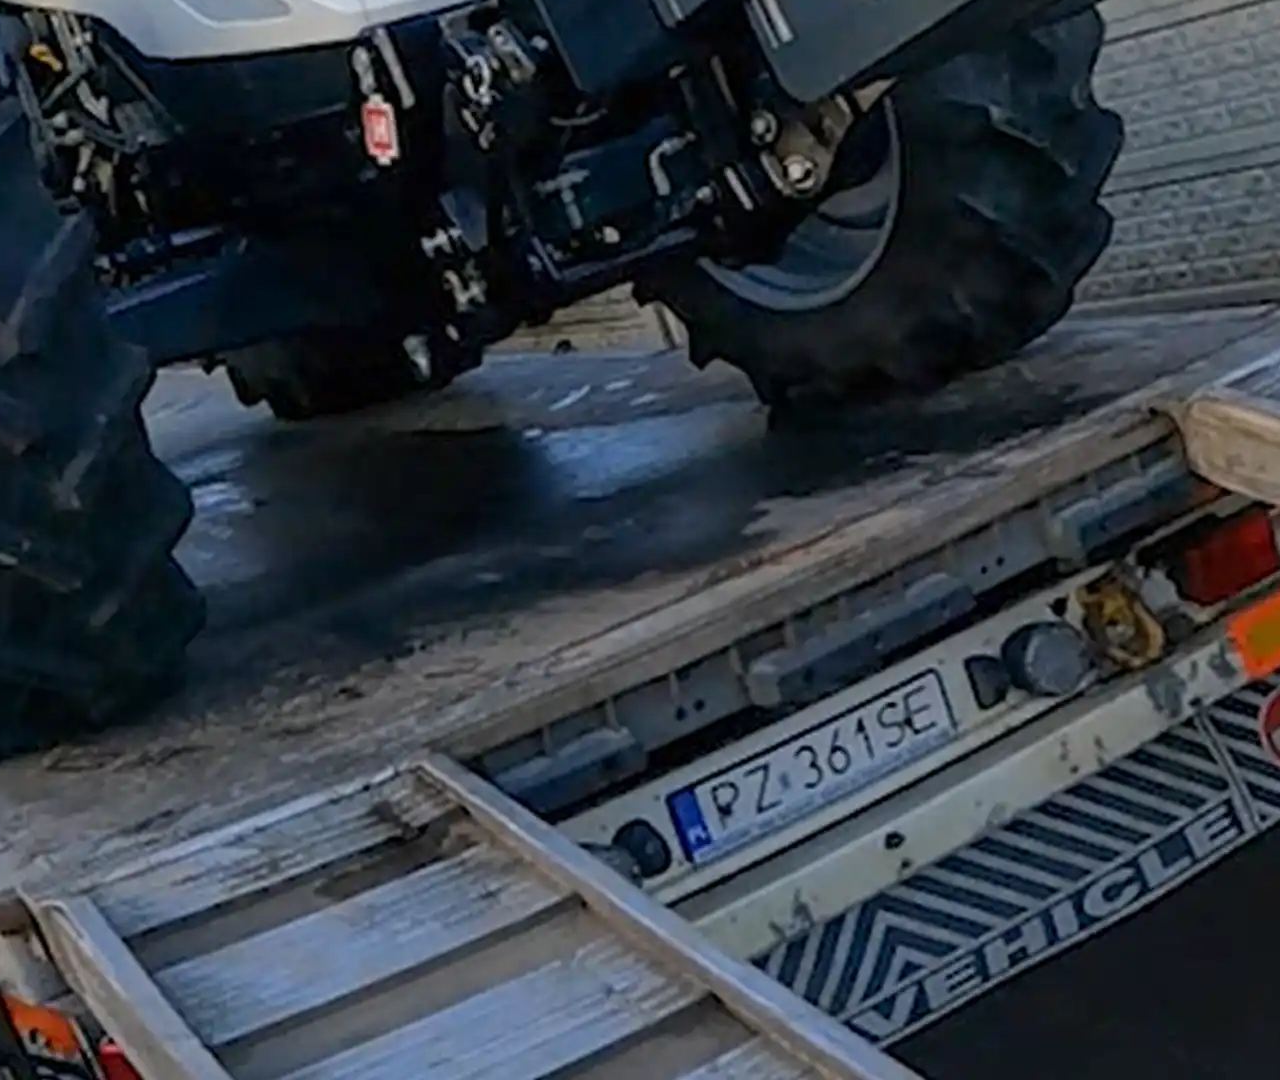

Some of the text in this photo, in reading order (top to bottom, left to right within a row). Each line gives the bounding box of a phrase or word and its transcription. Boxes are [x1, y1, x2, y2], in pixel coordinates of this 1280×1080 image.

[710, 684, 939, 829] PZ 361SE
[850, 803, 1242, 1040] VEHICLE
